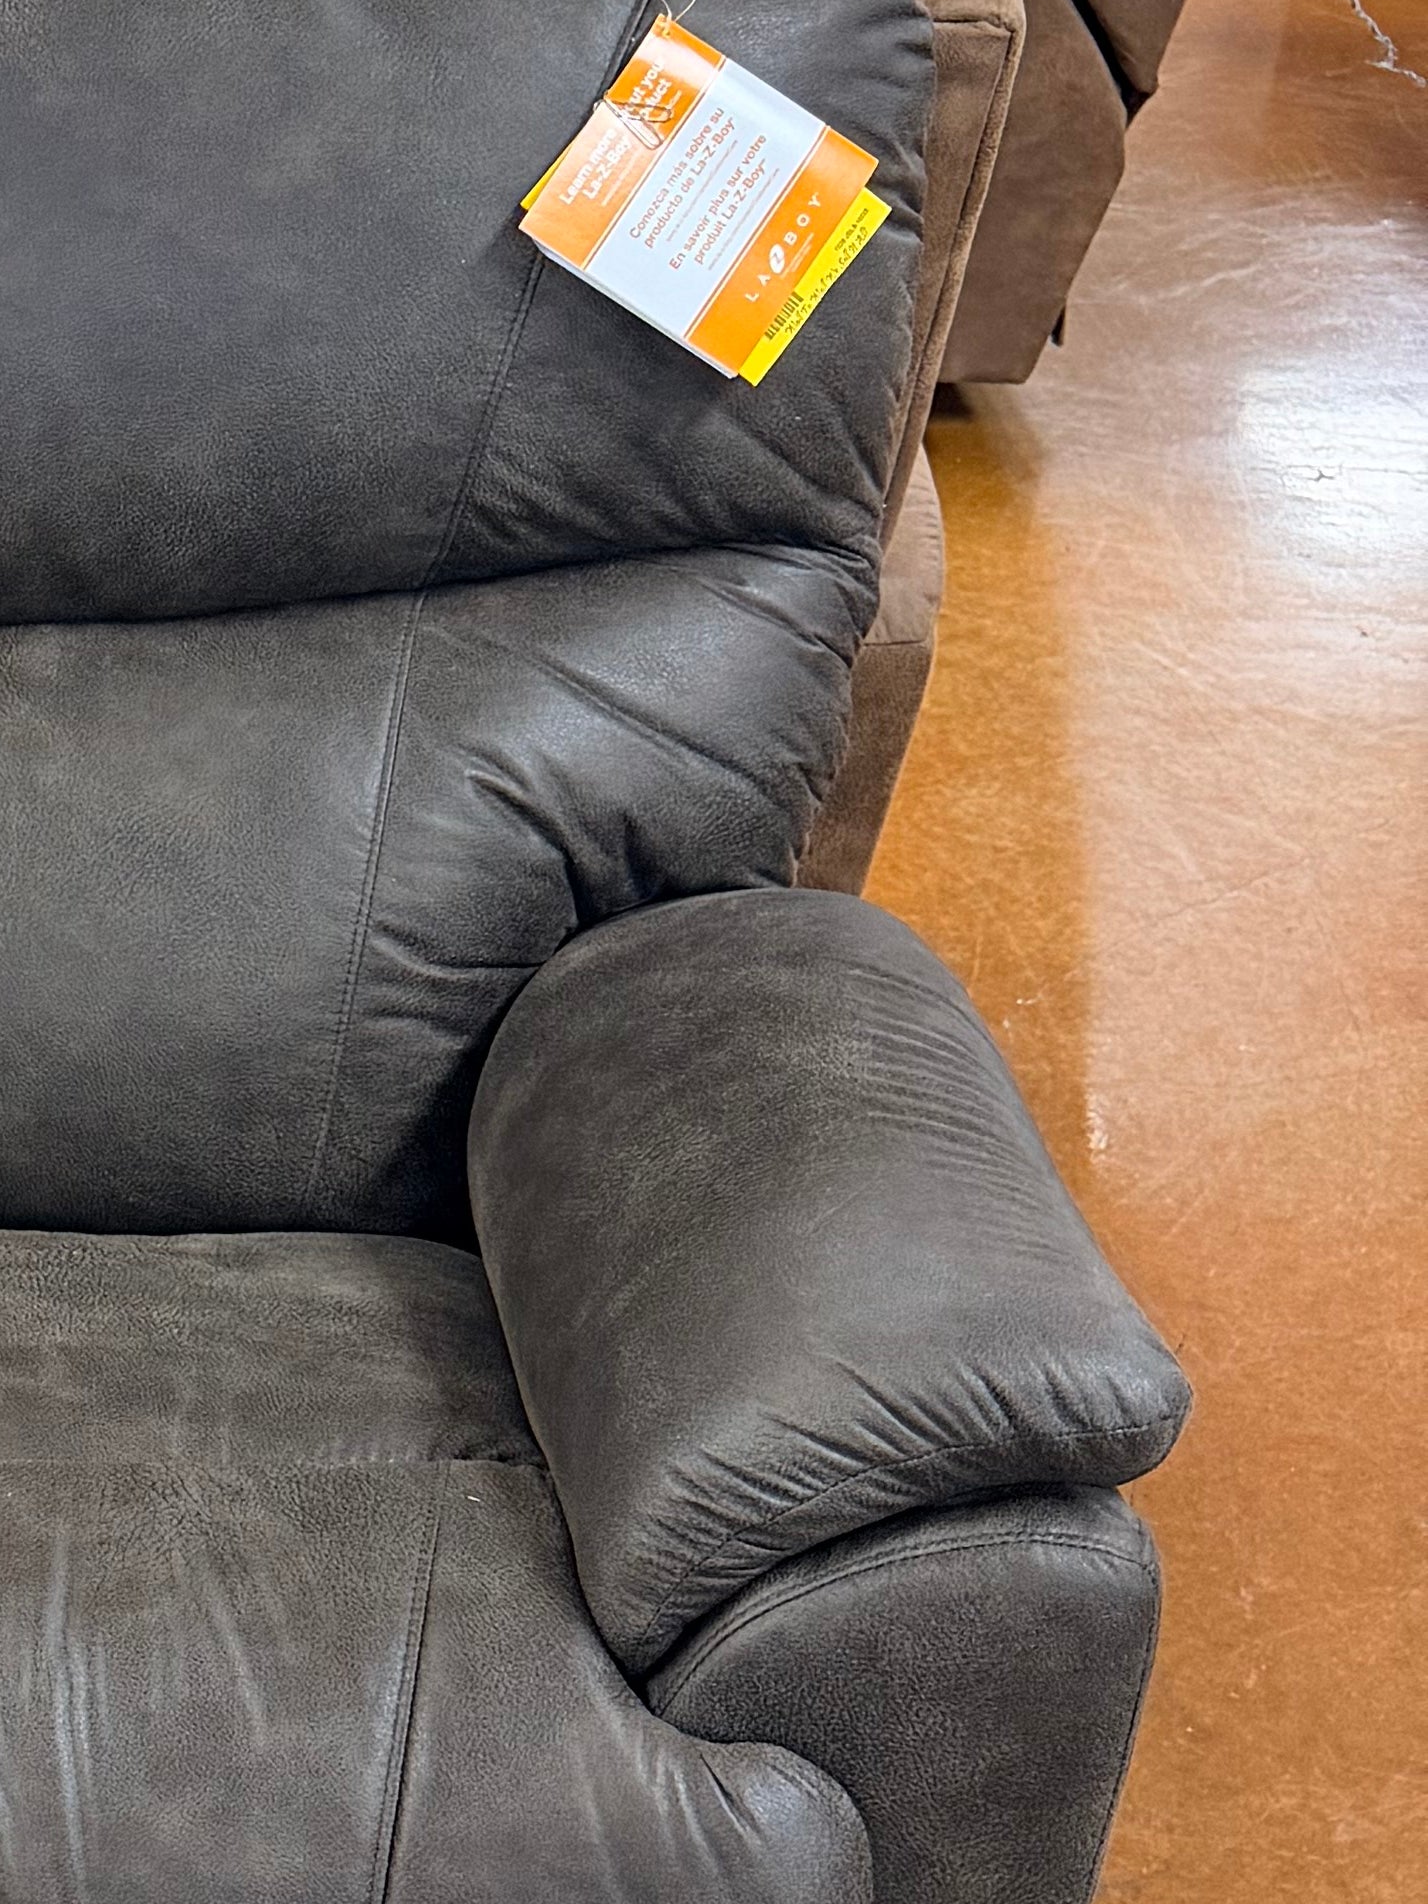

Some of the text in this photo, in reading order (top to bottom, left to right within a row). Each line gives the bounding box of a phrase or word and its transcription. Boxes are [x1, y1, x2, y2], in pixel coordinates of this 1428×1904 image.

[627, 106, 725, 240] Conozca más sobre su
[641, 191, 685, 249] producto
[677, 174, 696, 194] de
[667, 132, 767, 270] En savoir plus sur votre
[689, 217, 729, 265] produit
